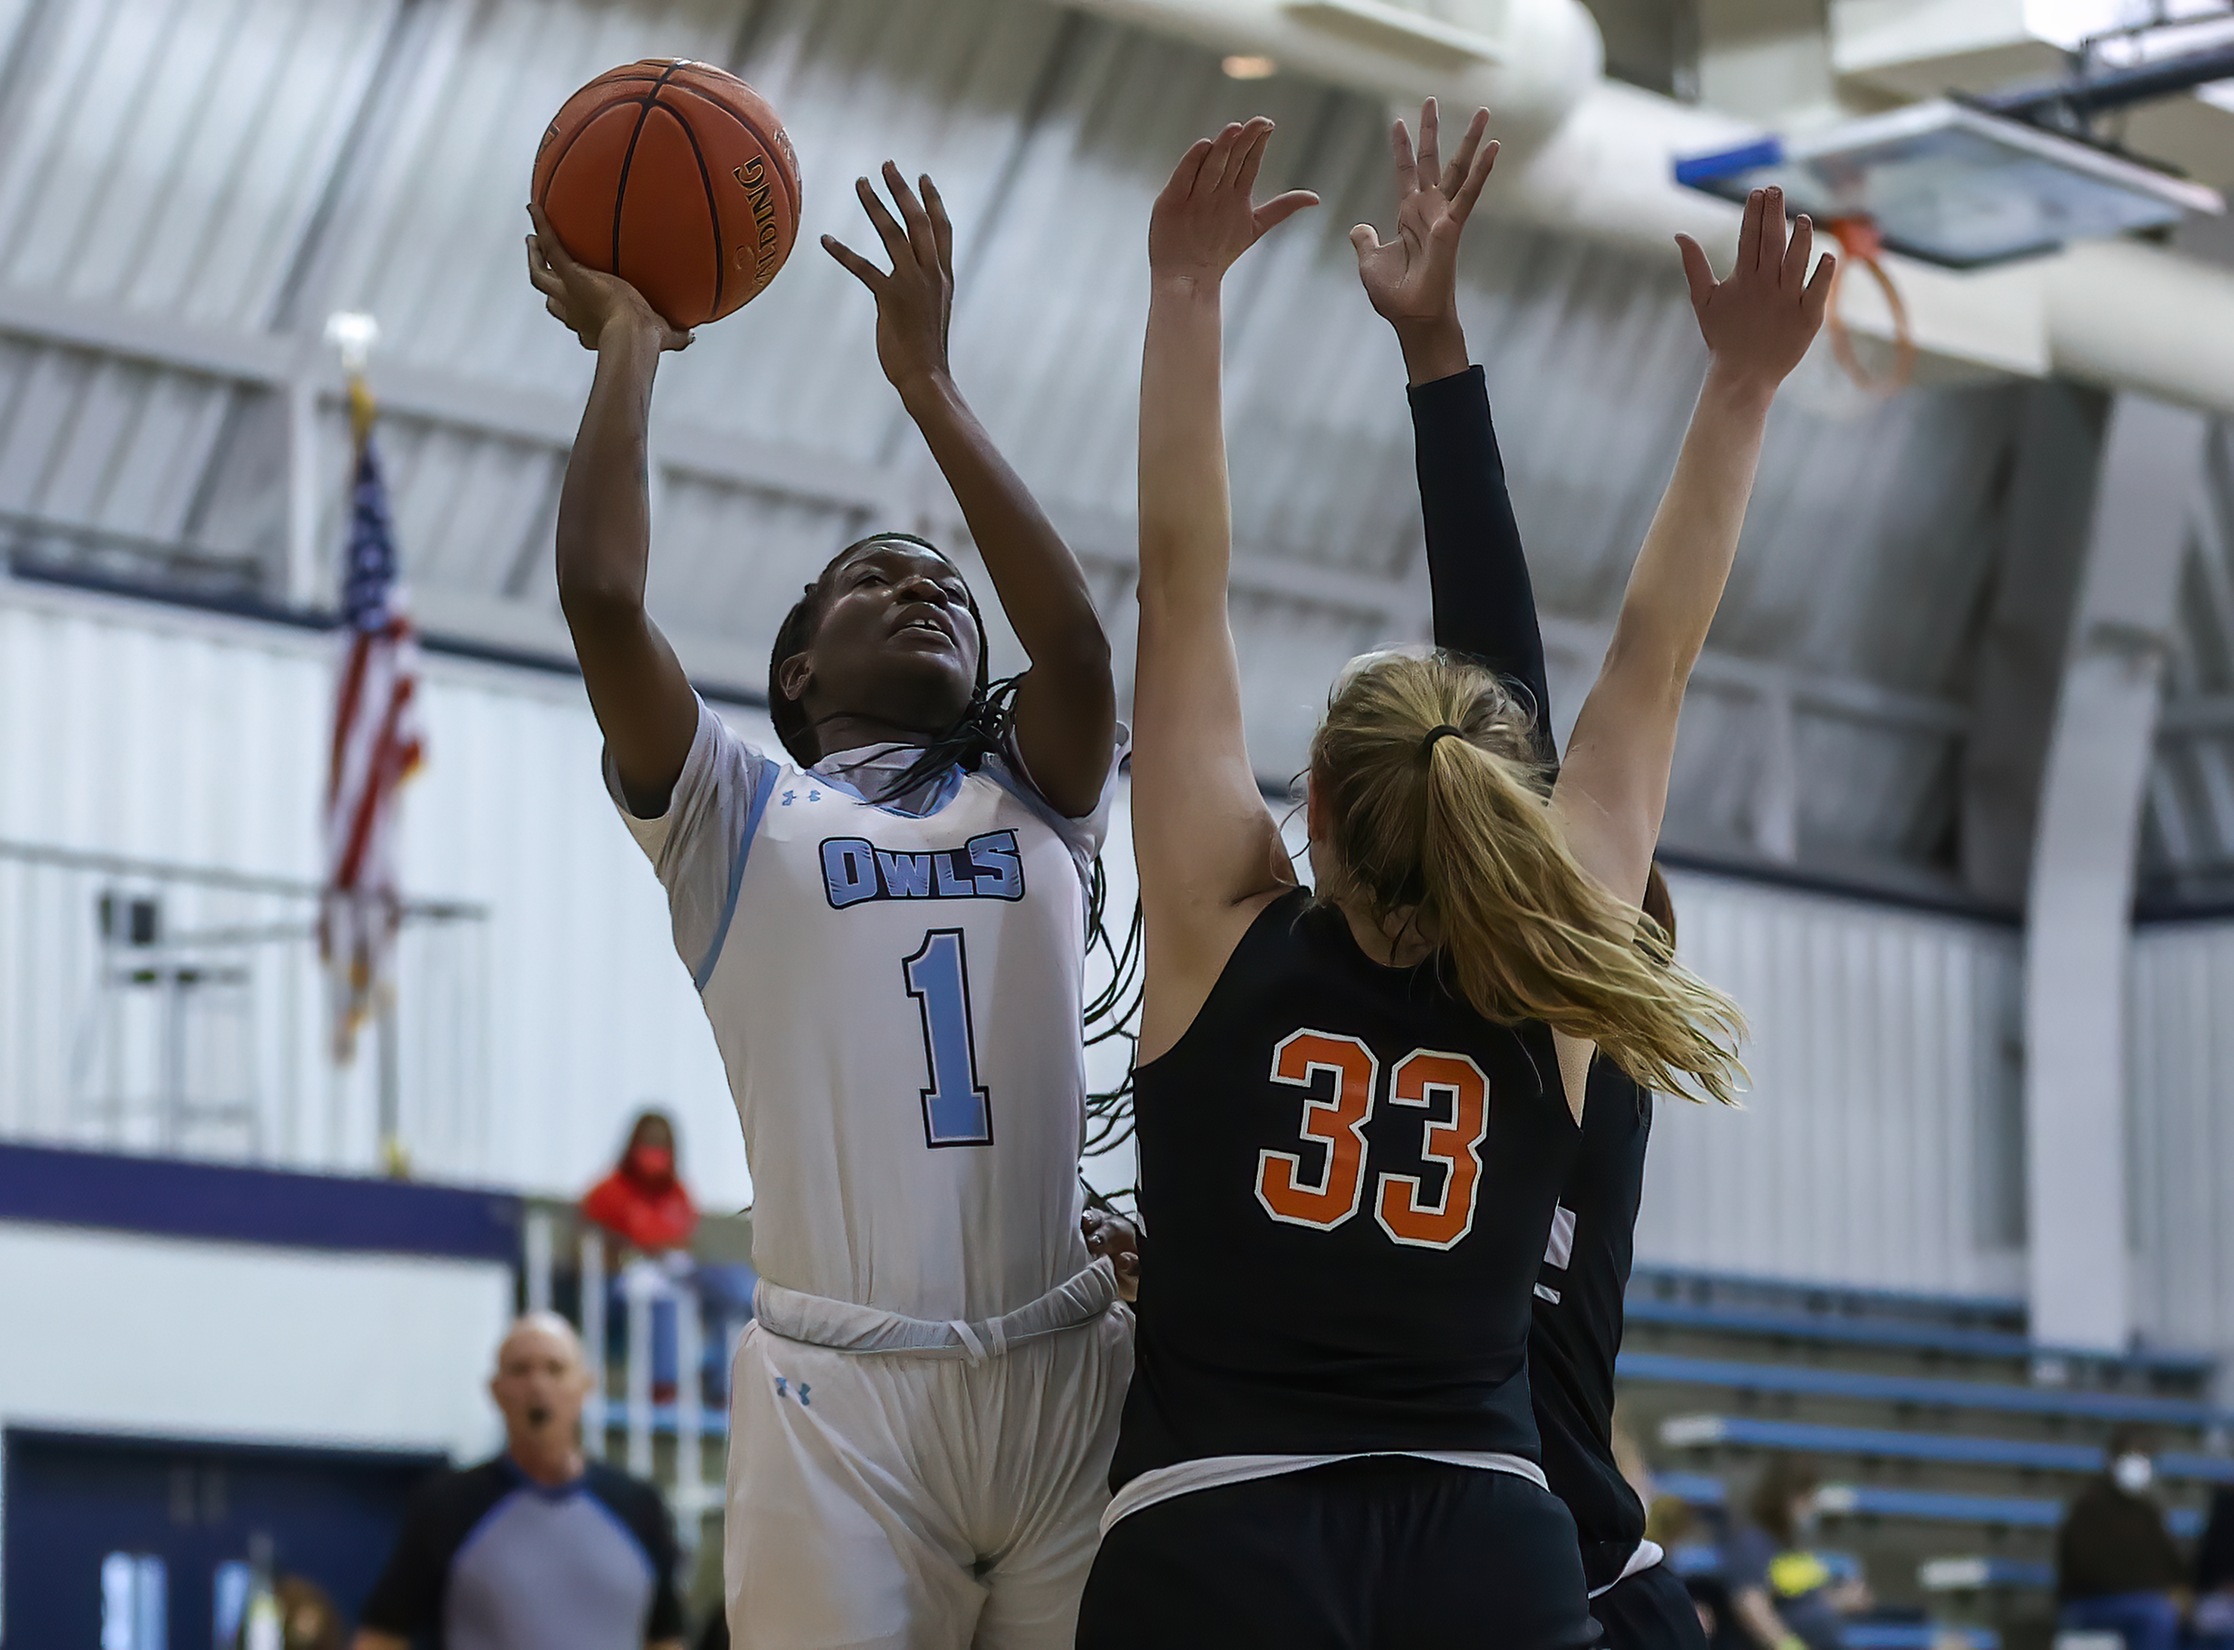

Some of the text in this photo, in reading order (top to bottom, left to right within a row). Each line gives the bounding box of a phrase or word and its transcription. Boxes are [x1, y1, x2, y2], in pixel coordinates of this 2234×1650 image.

[819, 828, 1025, 910] OWLS
[902, 927, 994, 1149] 1
[1254, 1027, 1490, 1251] 33
